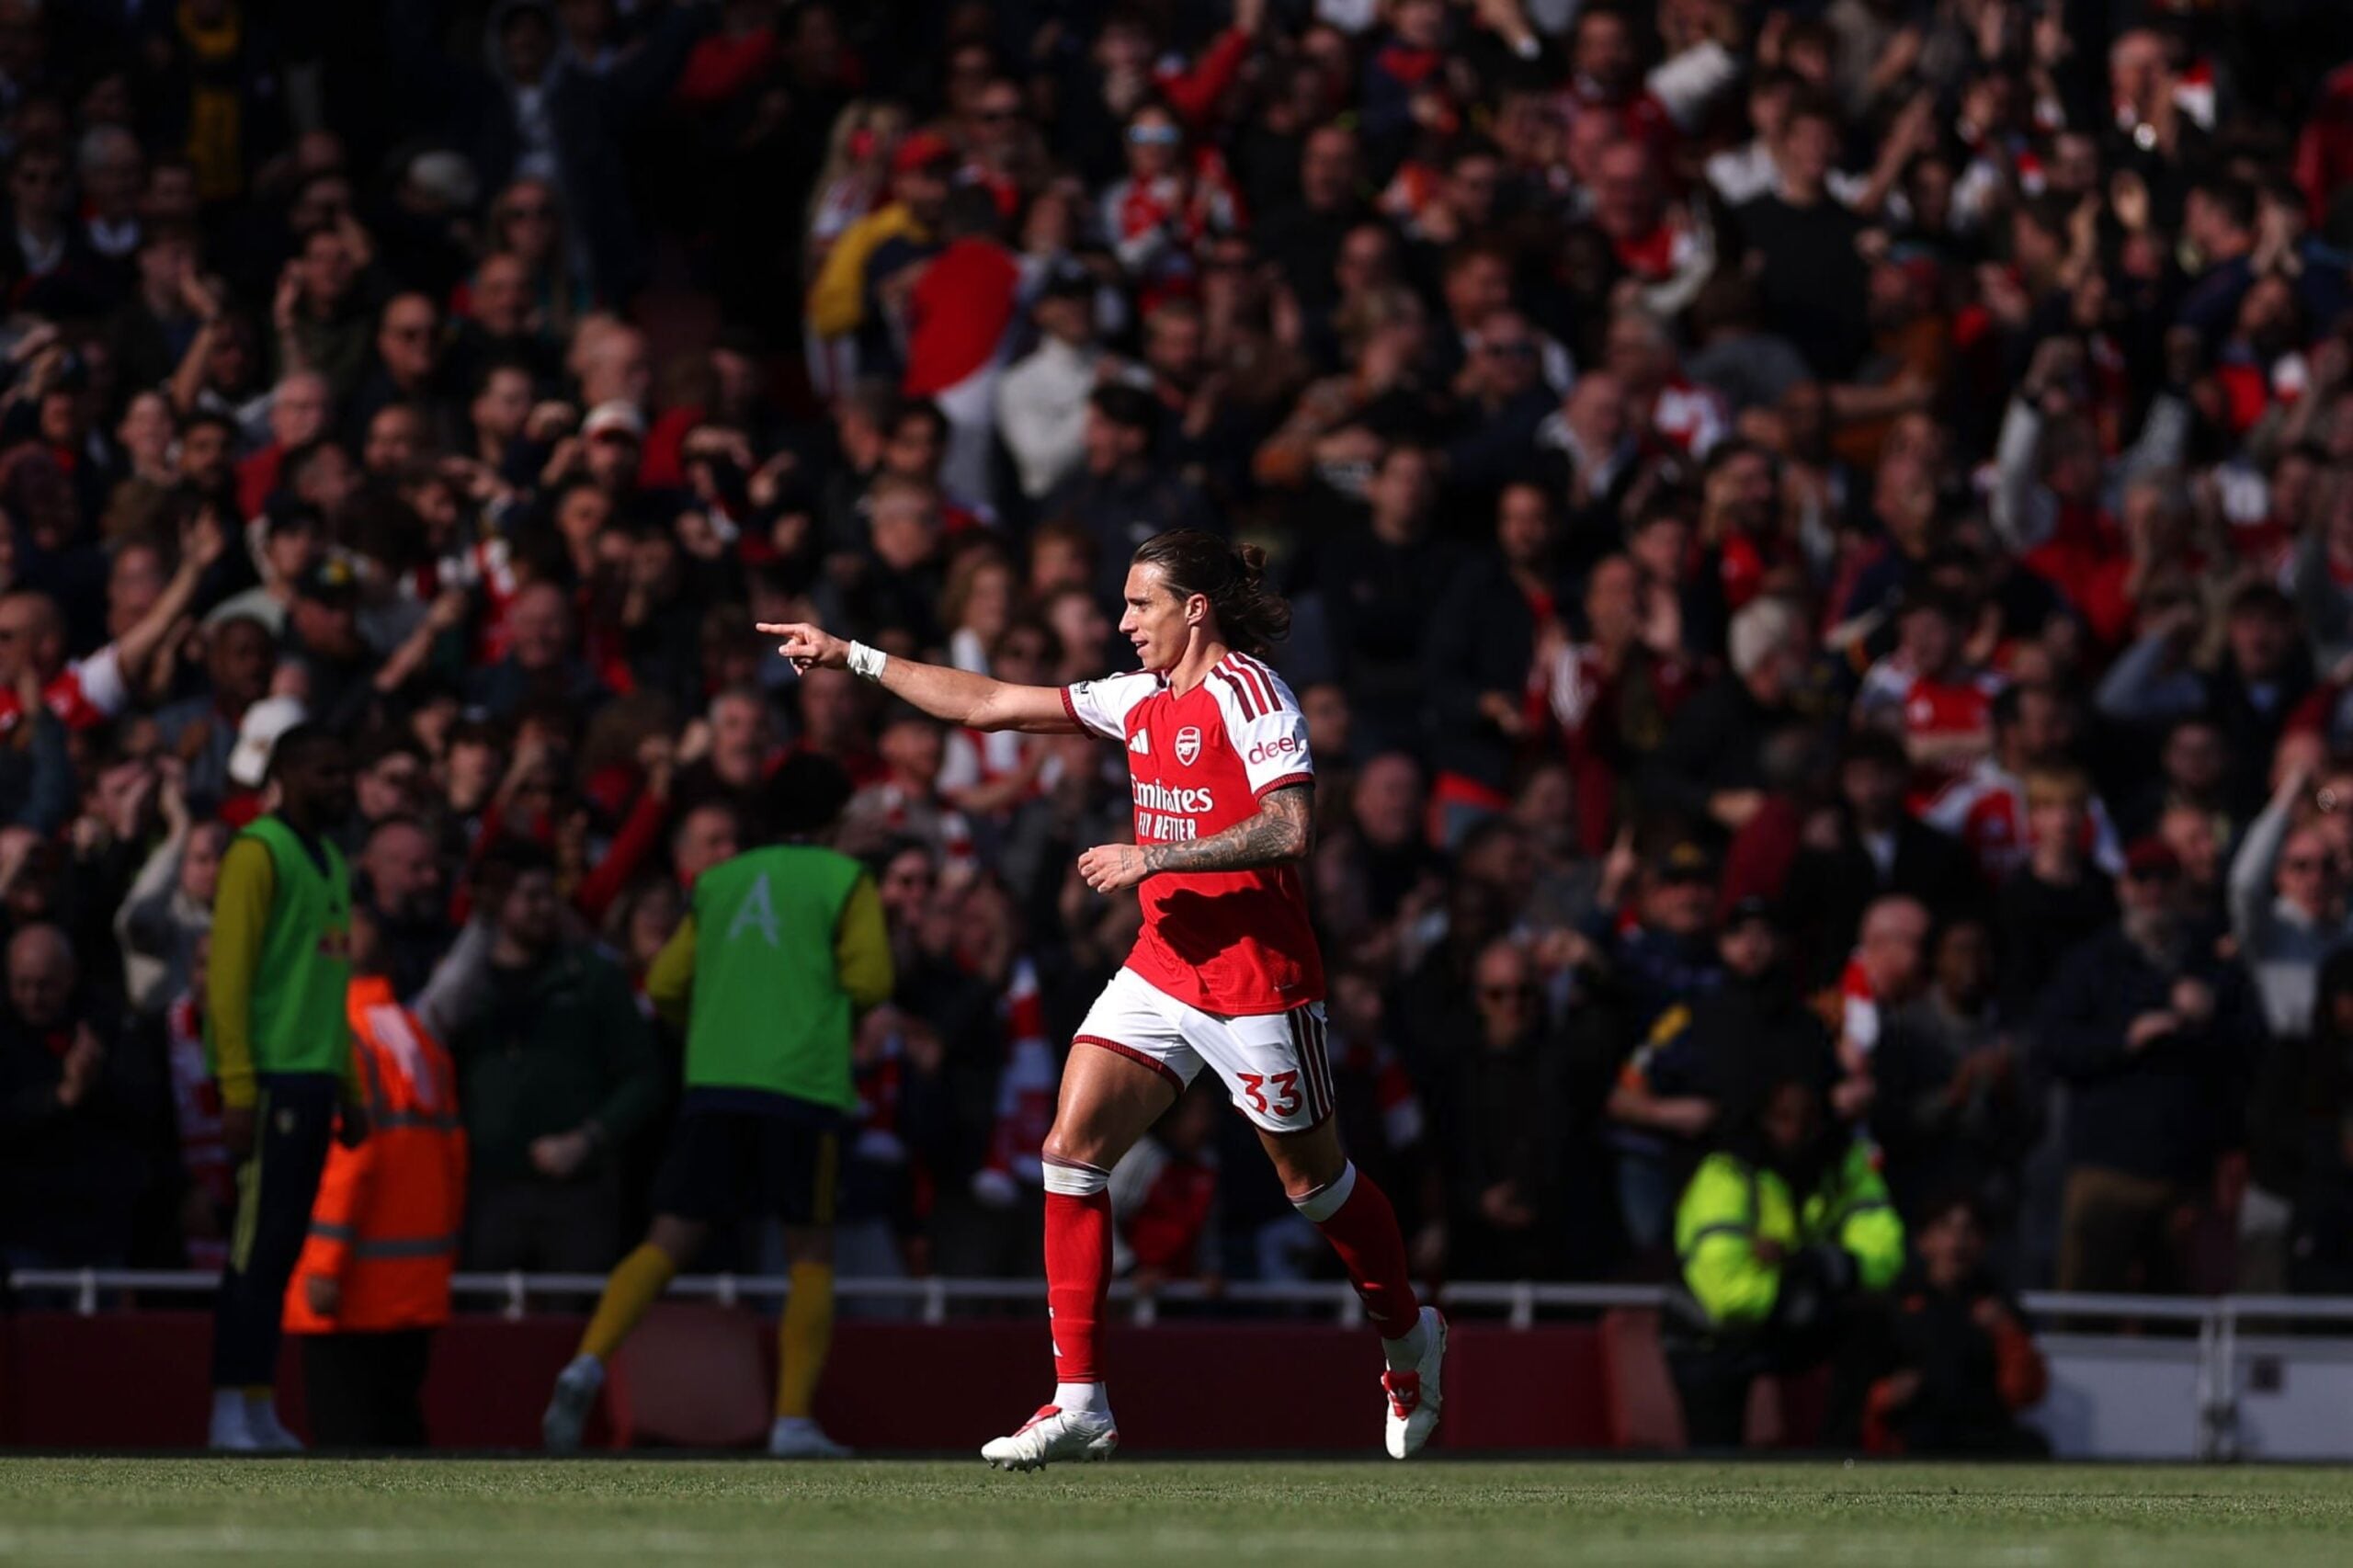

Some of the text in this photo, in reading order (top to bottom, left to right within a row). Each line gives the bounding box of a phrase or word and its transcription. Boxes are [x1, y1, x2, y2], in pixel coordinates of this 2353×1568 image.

[1154, 815, 1196, 841] BETTER
[728, 869, 779, 948] A
[1236, 1069, 1302, 1118] 33
